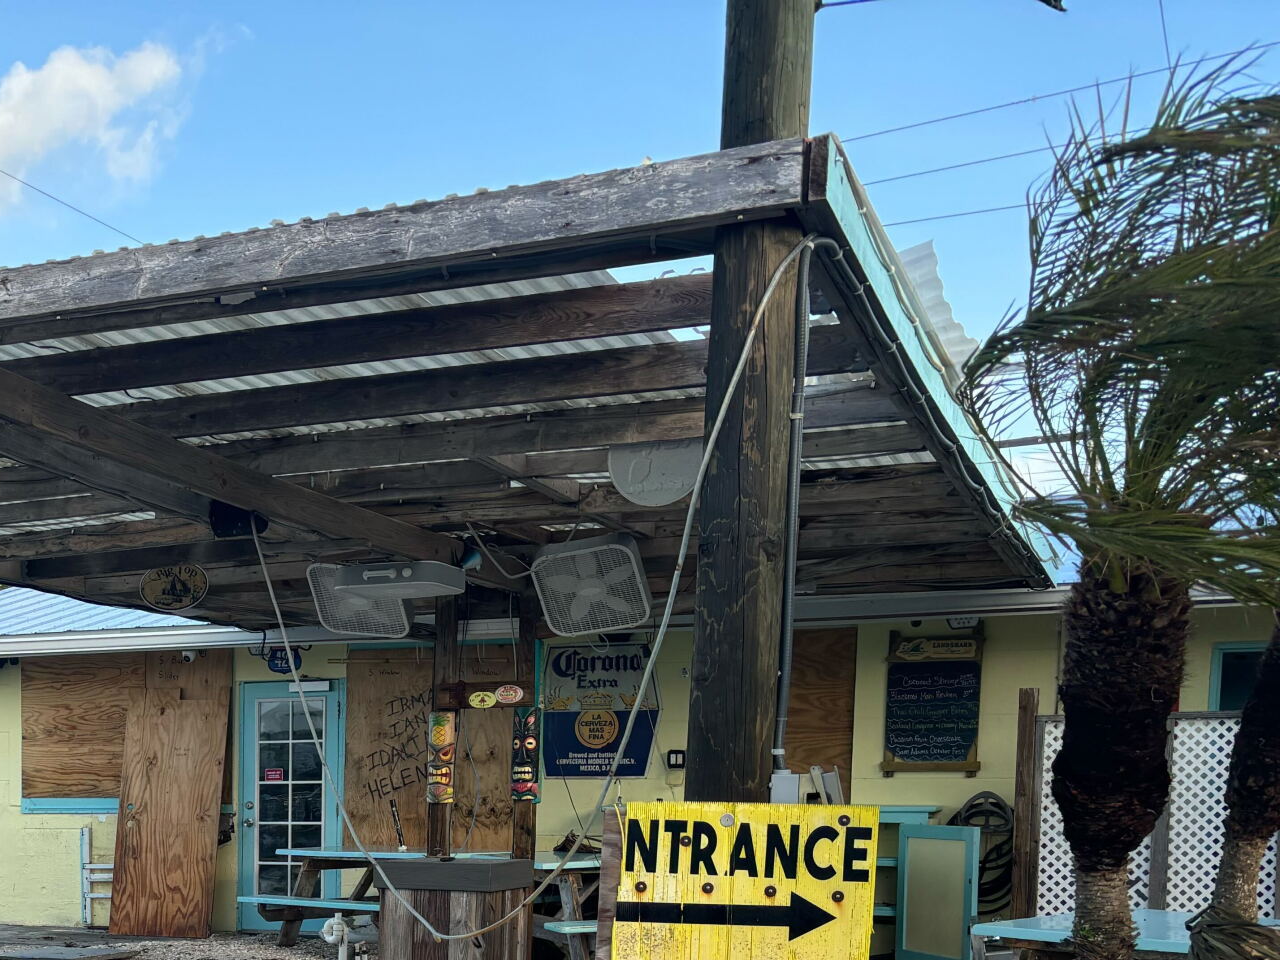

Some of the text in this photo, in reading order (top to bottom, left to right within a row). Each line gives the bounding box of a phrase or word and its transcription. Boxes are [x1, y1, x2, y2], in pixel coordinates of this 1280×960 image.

[552, 649, 644, 680] Corona
[576, 674, 618, 689] Extra
[389, 712, 428, 740] IAN
[367, 762, 428, 804] HELEN
[624, 818, 873, 883] NTRANCE
